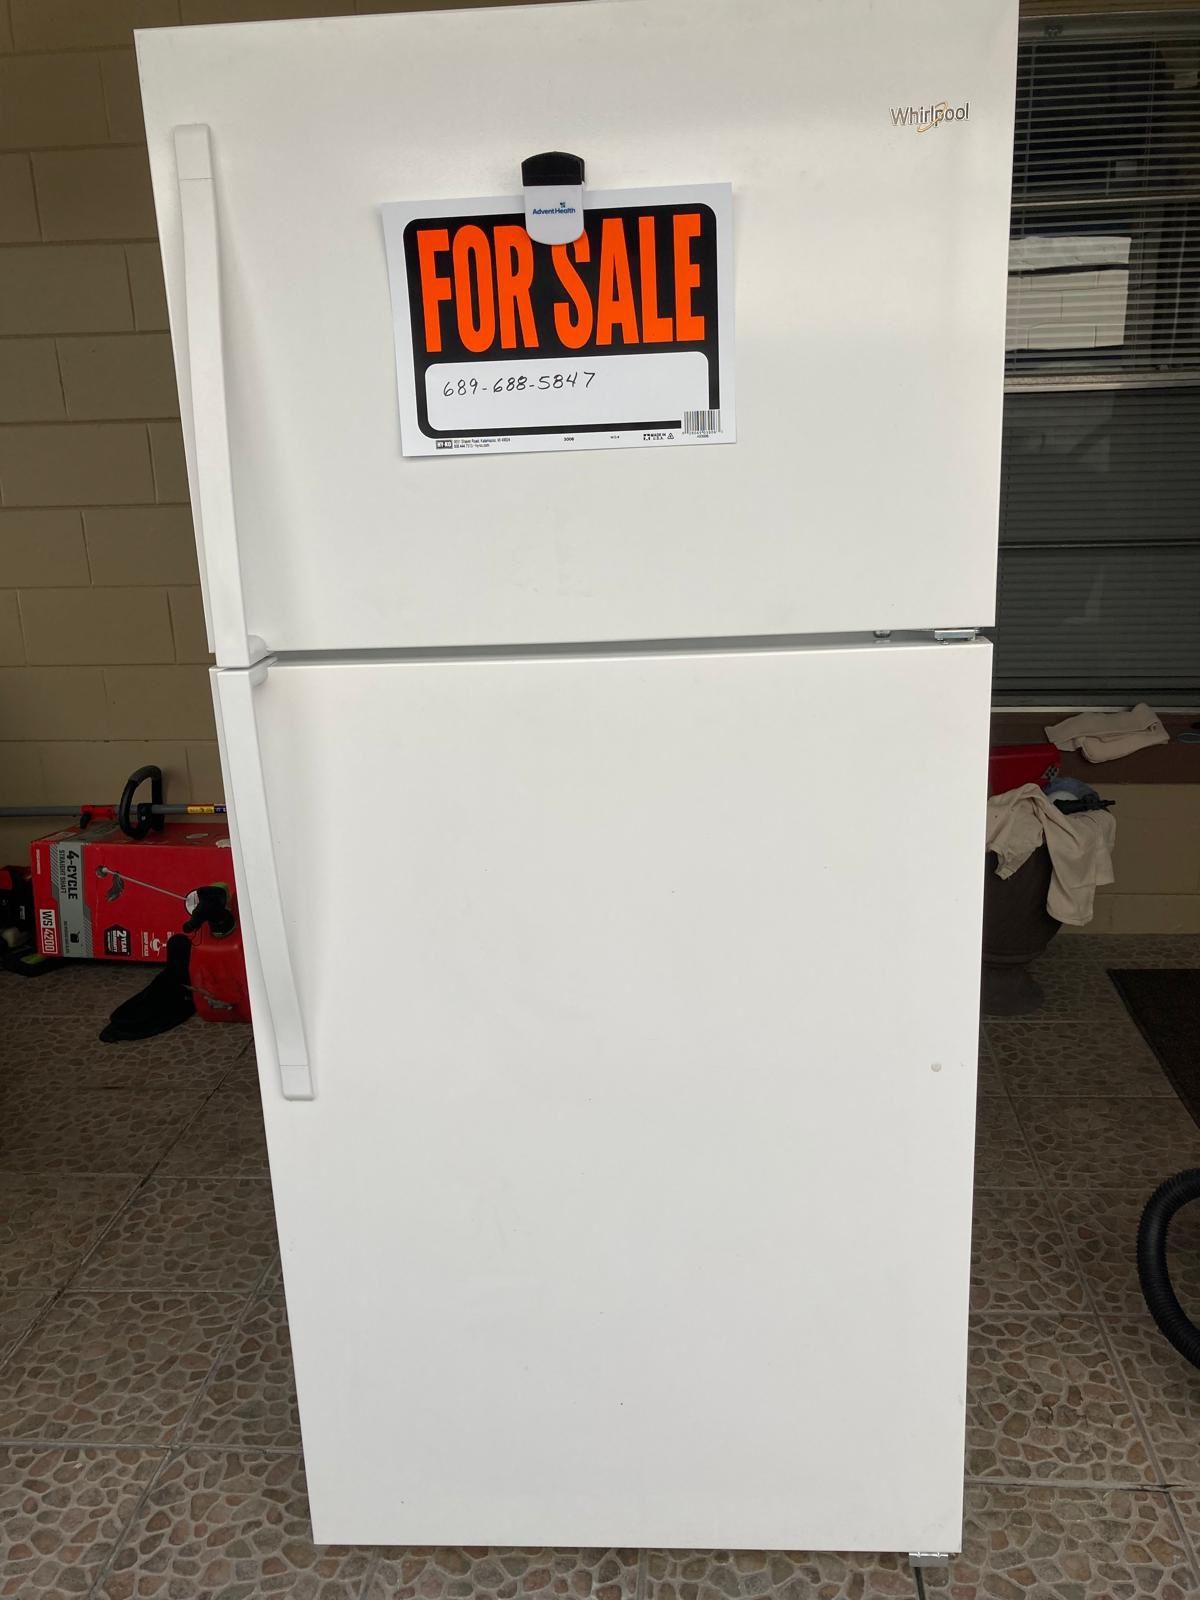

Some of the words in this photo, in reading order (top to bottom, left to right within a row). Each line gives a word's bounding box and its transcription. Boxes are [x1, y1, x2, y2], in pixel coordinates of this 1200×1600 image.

[891, 102, 969, 127] Whirlpool
[417, 224, 539, 353] FOR
[551, 213, 705, 349] SALE
[443, 371, 595, 397] 689-688-5847
[66, 850, 79, 900] 4-CYCLE
